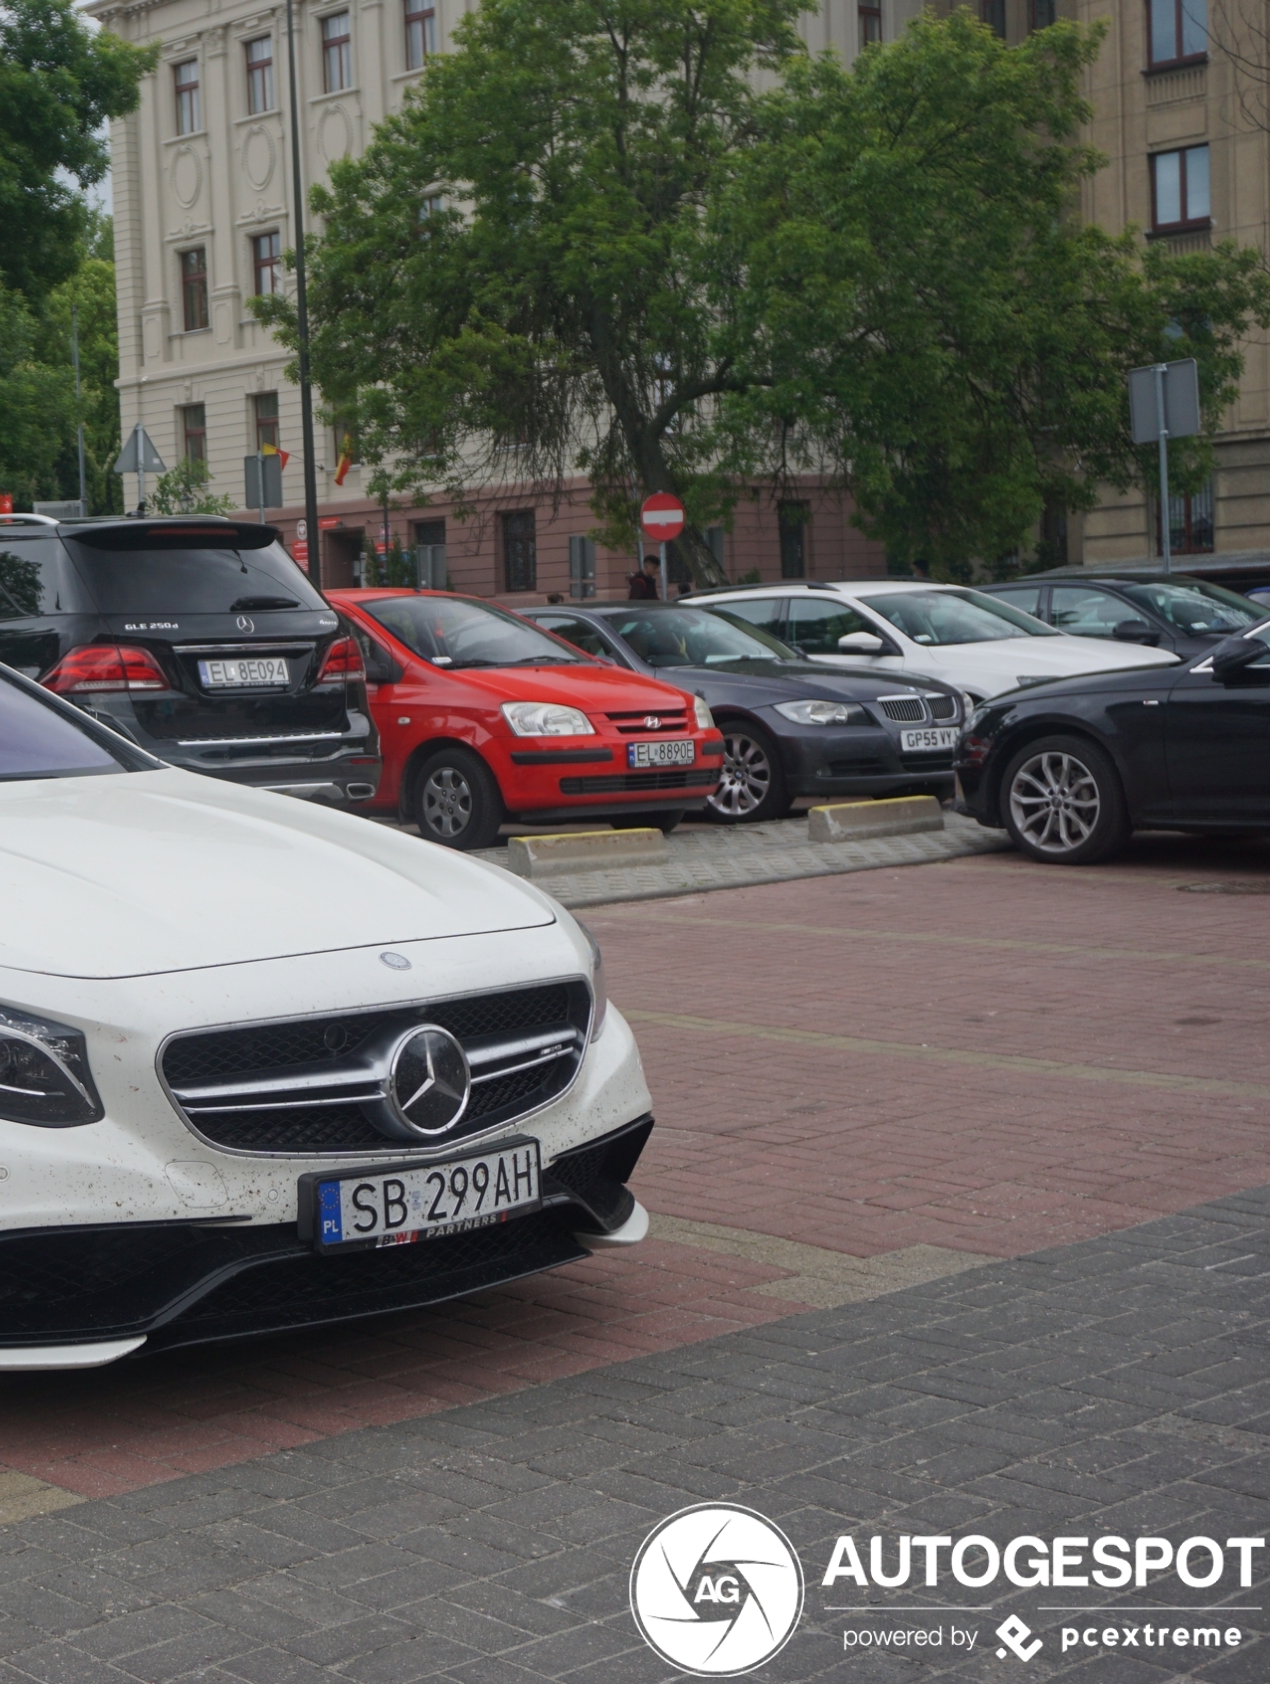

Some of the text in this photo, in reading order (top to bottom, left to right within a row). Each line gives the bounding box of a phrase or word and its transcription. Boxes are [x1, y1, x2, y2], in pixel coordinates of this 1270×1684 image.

[124, 621, 179, 631] GLE 250d
[209, 662, 234, 682] EL
[238, 660, 286, 681] 8E094
[906, 731, 938, 748] GP55
[637, 742, 693, 762] EL 8890E
[351, 1150, 531, 1233] SB 299AH
[323, 1219, 339, 1234] PL
[426, 1213, 497, 1238] PARTNERS
